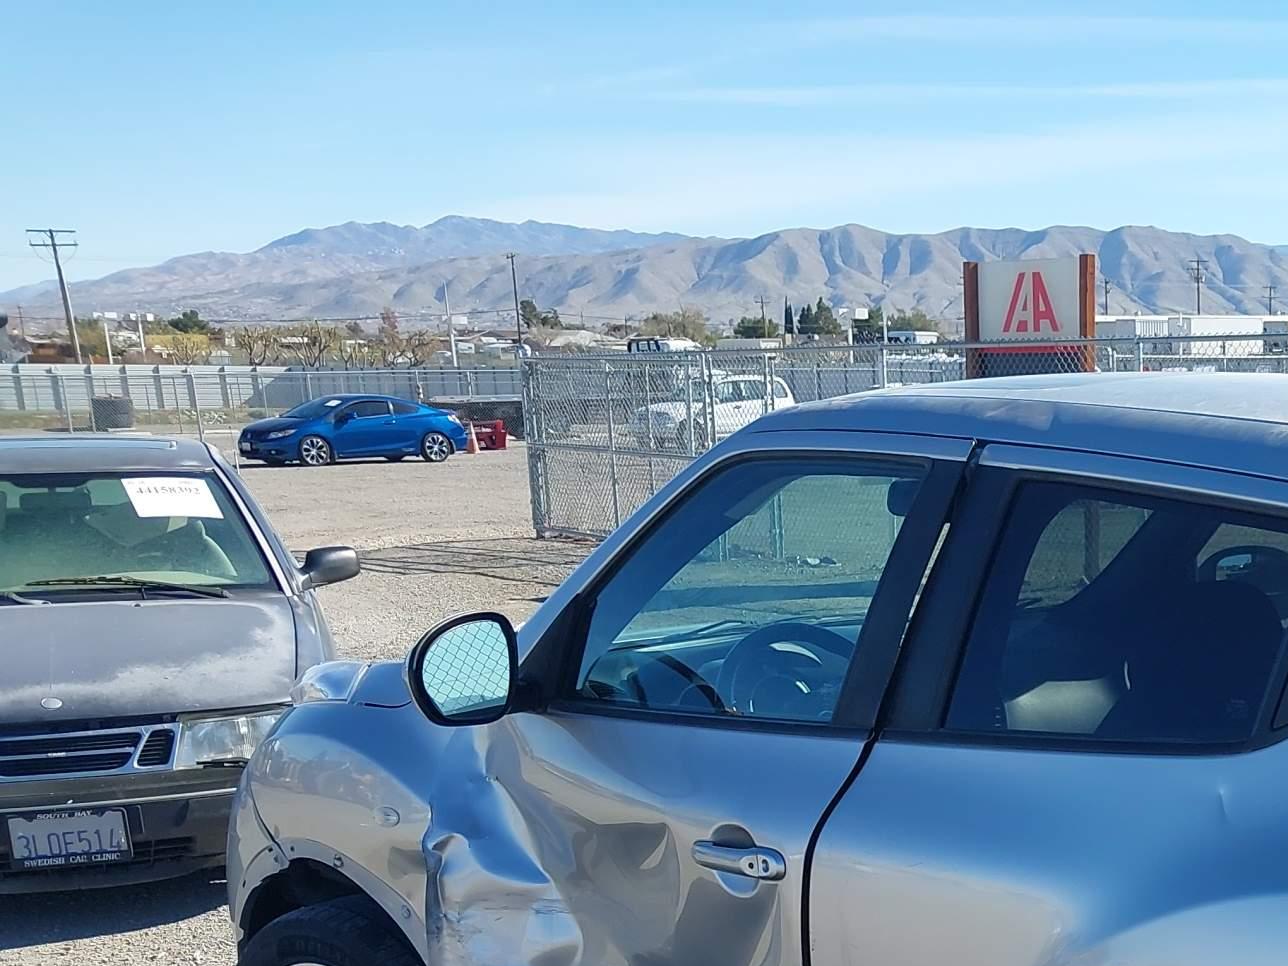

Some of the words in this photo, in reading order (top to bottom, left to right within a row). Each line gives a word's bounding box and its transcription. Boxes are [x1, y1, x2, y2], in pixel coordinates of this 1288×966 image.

[37, 811, 70, 820] SOUTH
[74, 809, 93, 817] BAY
[24, 856, 65, 868] SWEDISH
[69, 855, 87, 863] CAR
[91, 852, 120, 861] CLINIC
